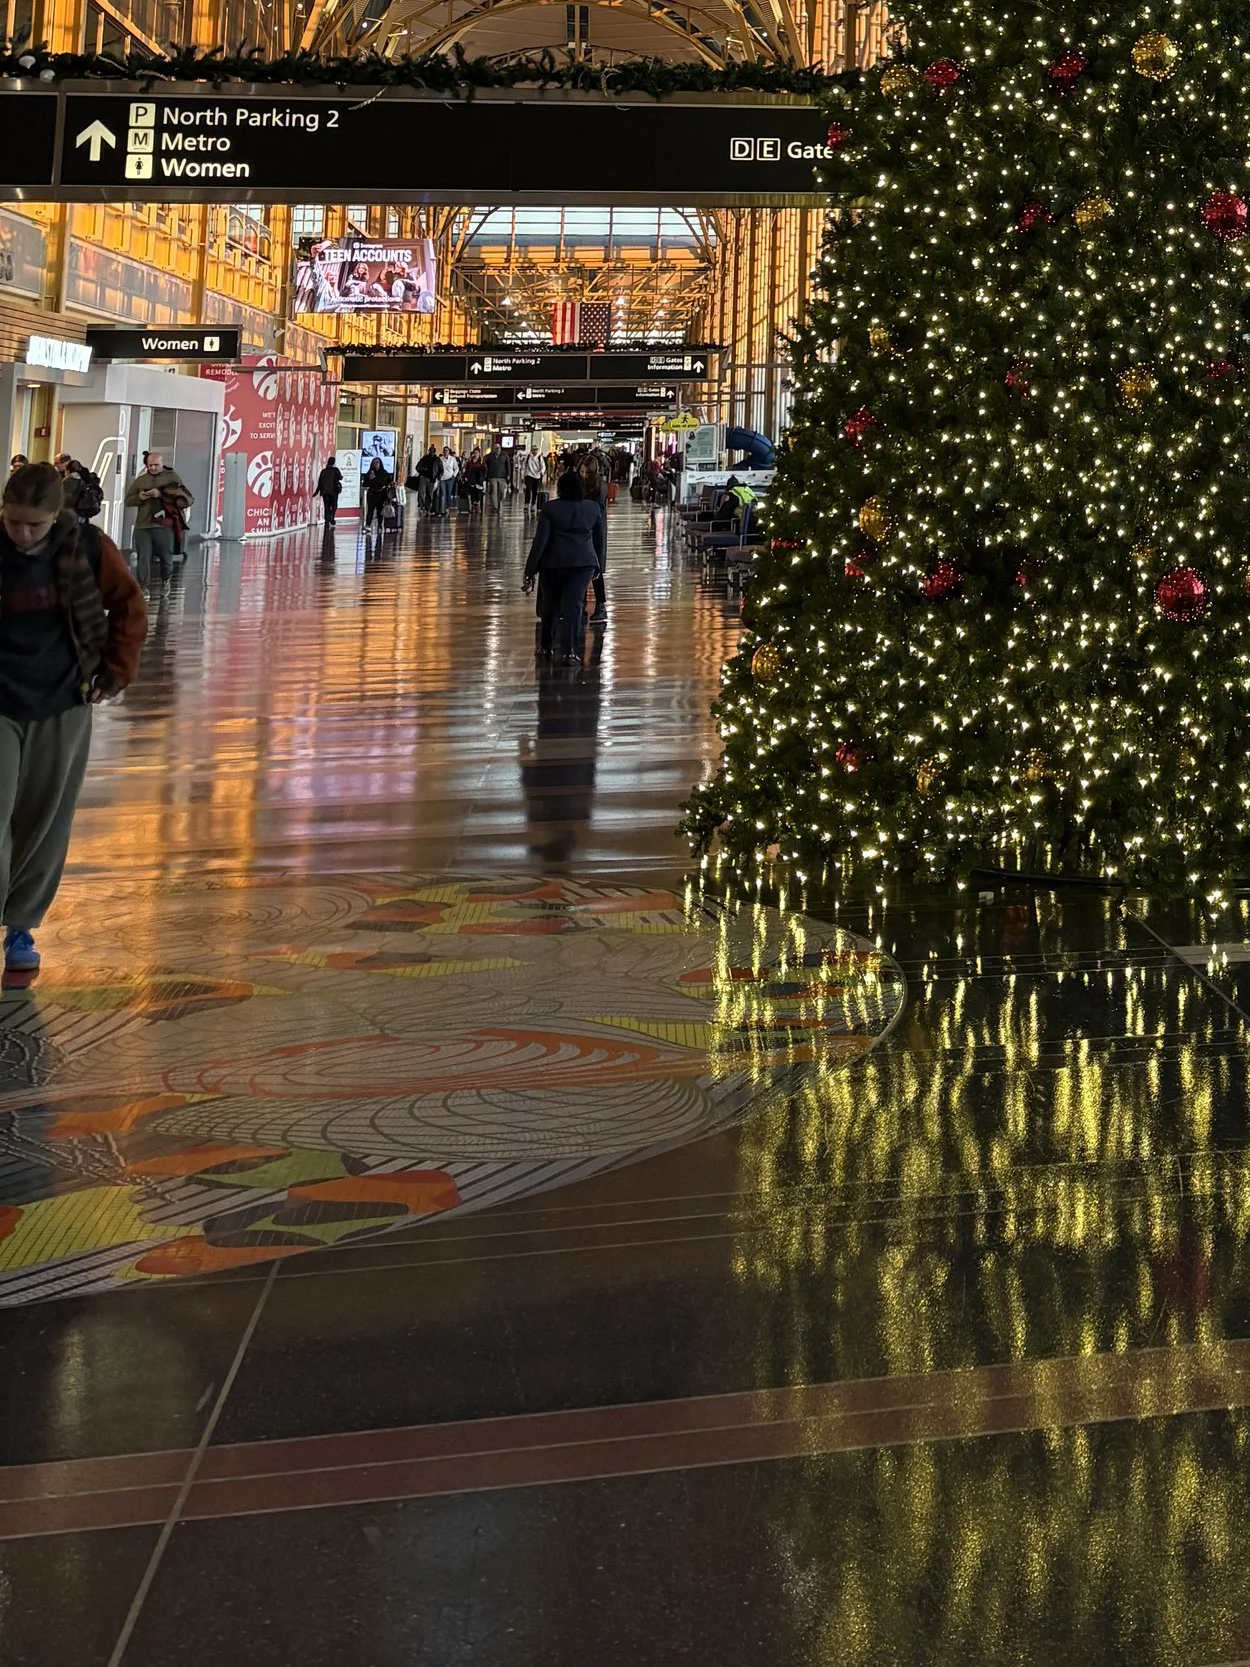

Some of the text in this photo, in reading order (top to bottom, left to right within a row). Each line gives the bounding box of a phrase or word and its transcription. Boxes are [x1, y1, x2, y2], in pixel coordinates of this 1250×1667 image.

[135, 107, 339, 132] P North Parking 2
[134, 132, 231, 153] M Metro
[734, 142, 833, 159] D E Gate
[161, 159, 249, 179] Women
[324, 250, 412, 262] TEEN ACCOUNTS
[142, 338, 198, 351] Women
